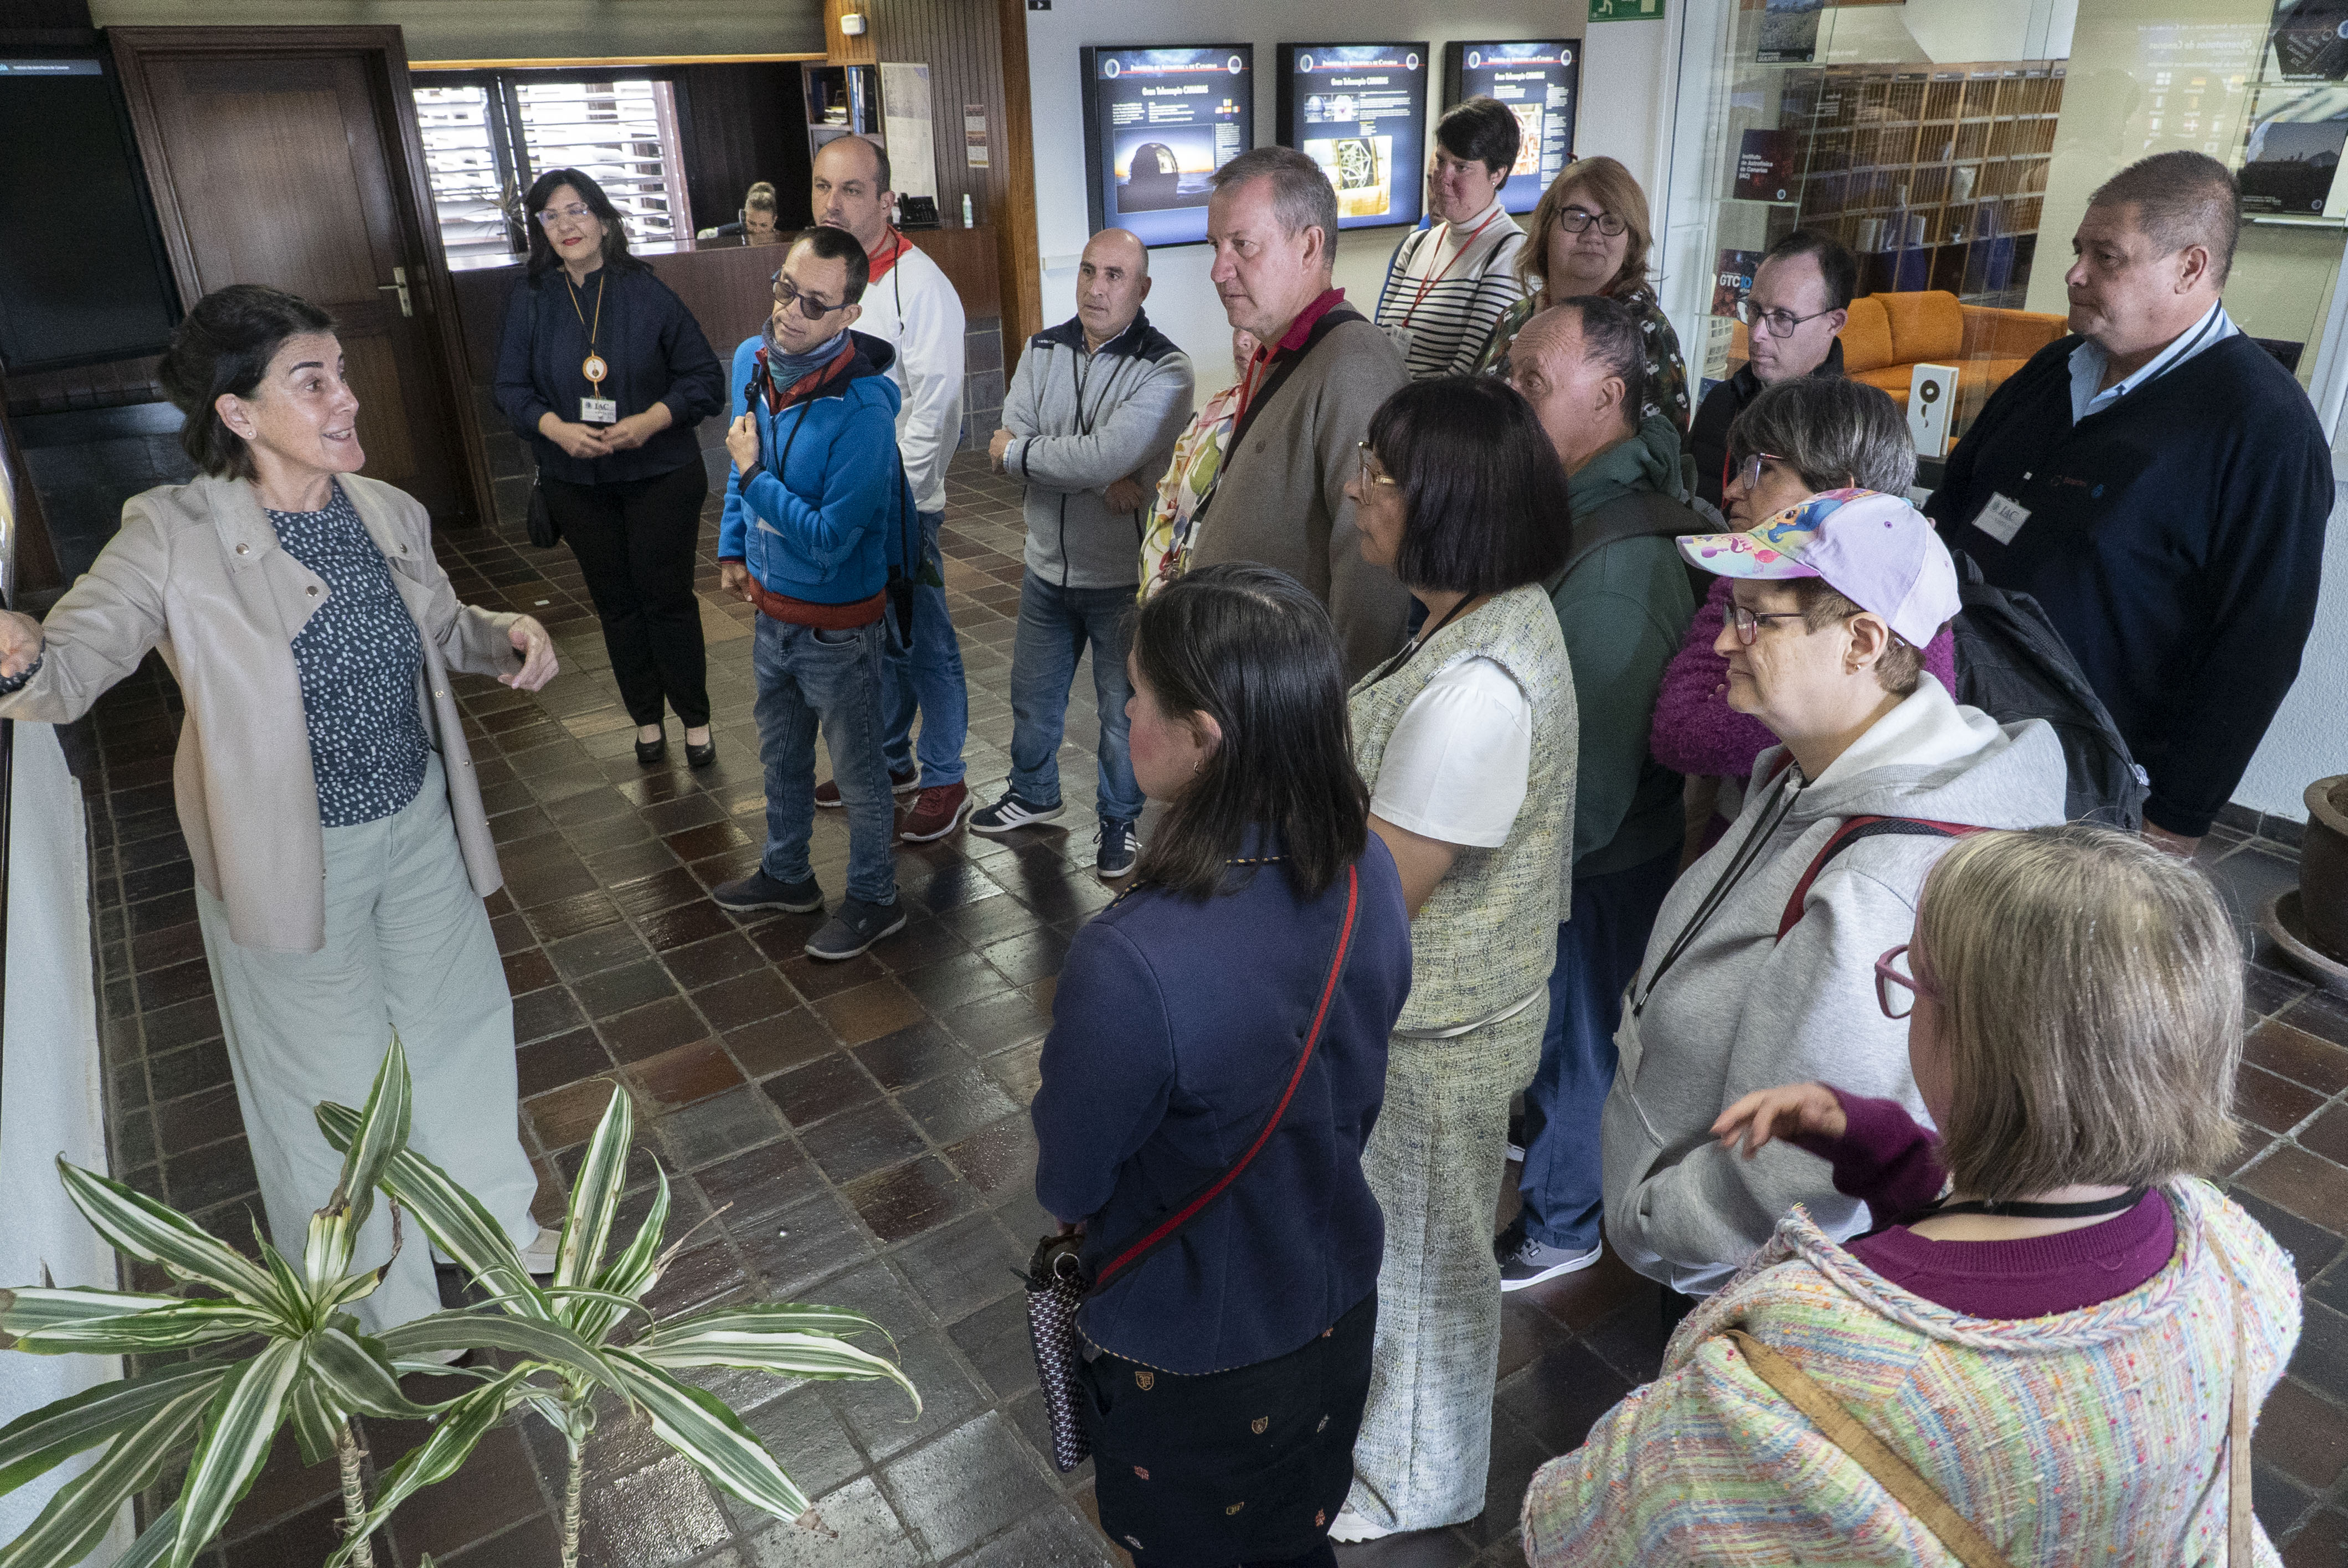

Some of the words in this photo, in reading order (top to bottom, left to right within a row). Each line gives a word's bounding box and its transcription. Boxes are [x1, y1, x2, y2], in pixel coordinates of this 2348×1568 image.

[1142, 87, 1156, 96] Gran
[1156, 86, 1182, 96] Telescopio
[1183, 85, 1208, 94] CANARIAS
